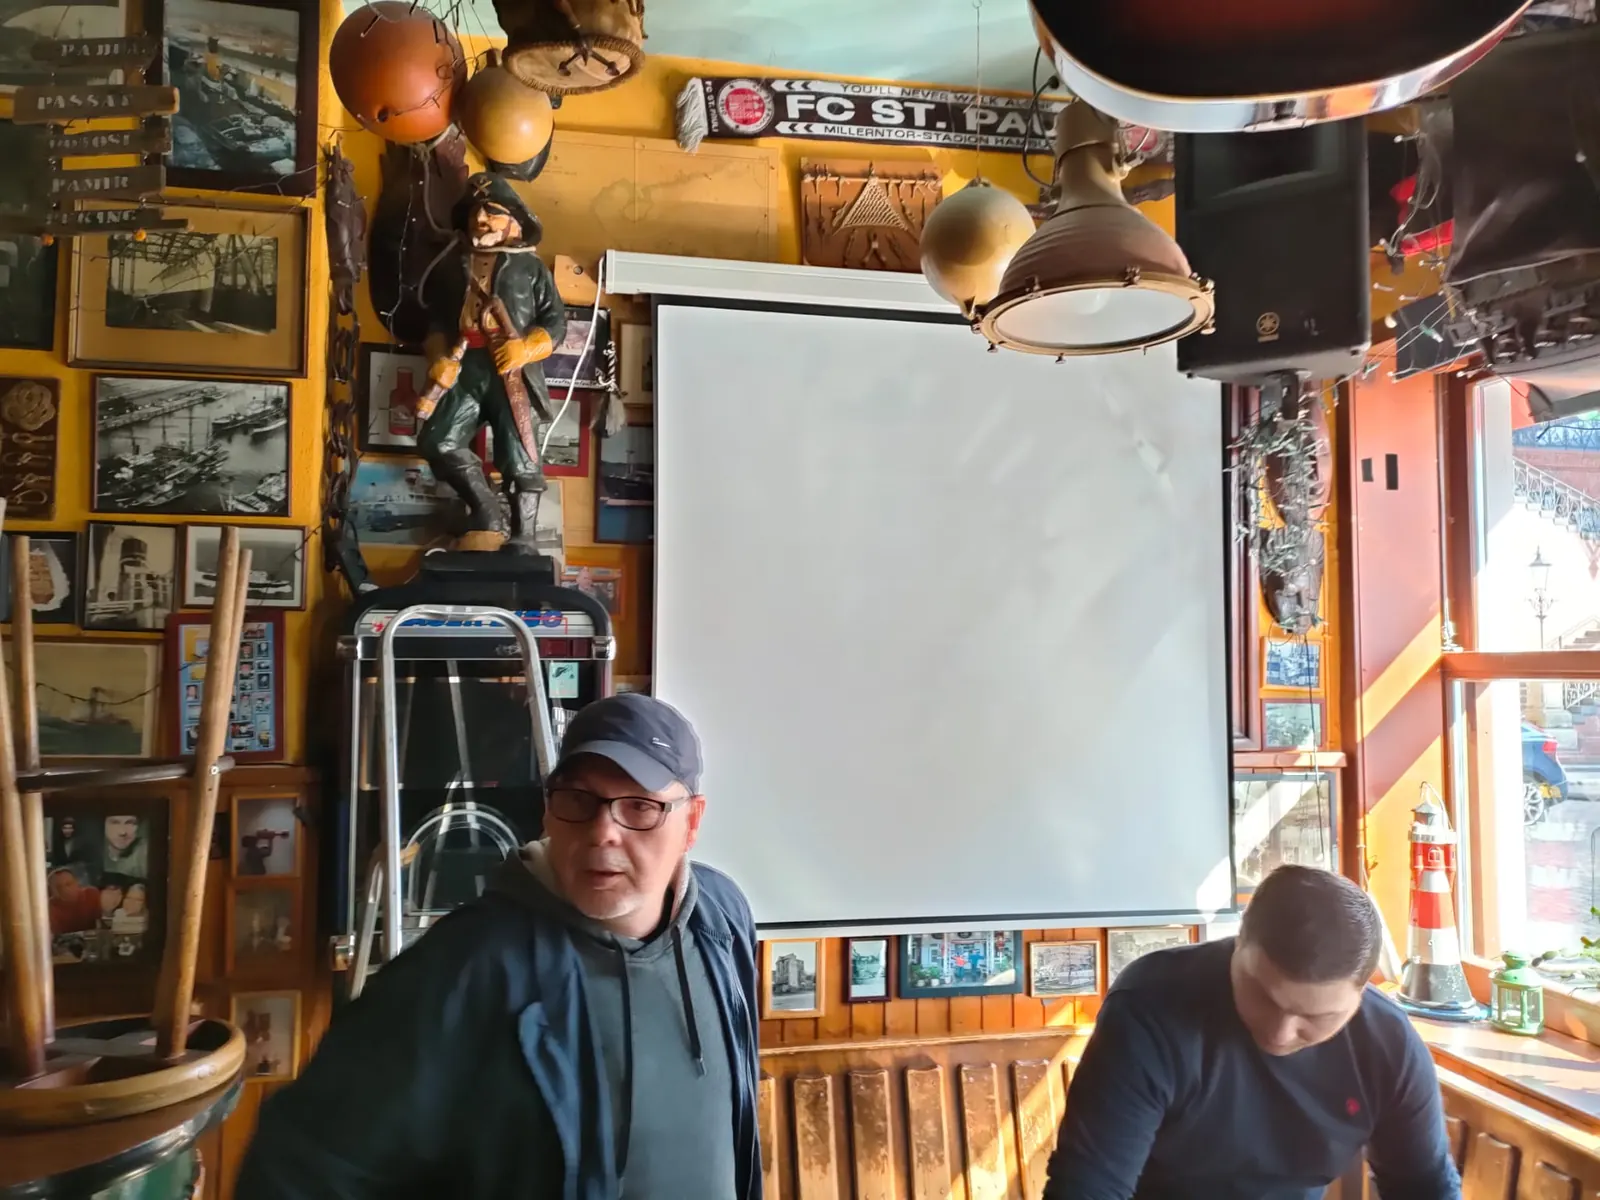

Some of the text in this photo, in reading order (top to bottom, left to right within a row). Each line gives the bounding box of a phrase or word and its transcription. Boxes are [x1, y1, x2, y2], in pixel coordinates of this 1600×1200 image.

[841, 84, 894, 96] YOU'LL
[900, 86, 950, 101] NEVER
[953, 93, 998, 106] WALK
[786, 94, 855, 121] FC
[871, 99, 947, 129] ST.
[824, 125, 989, 145] MILLERNTOR-STADION
[52, 175, 129, 193] PAMIR
